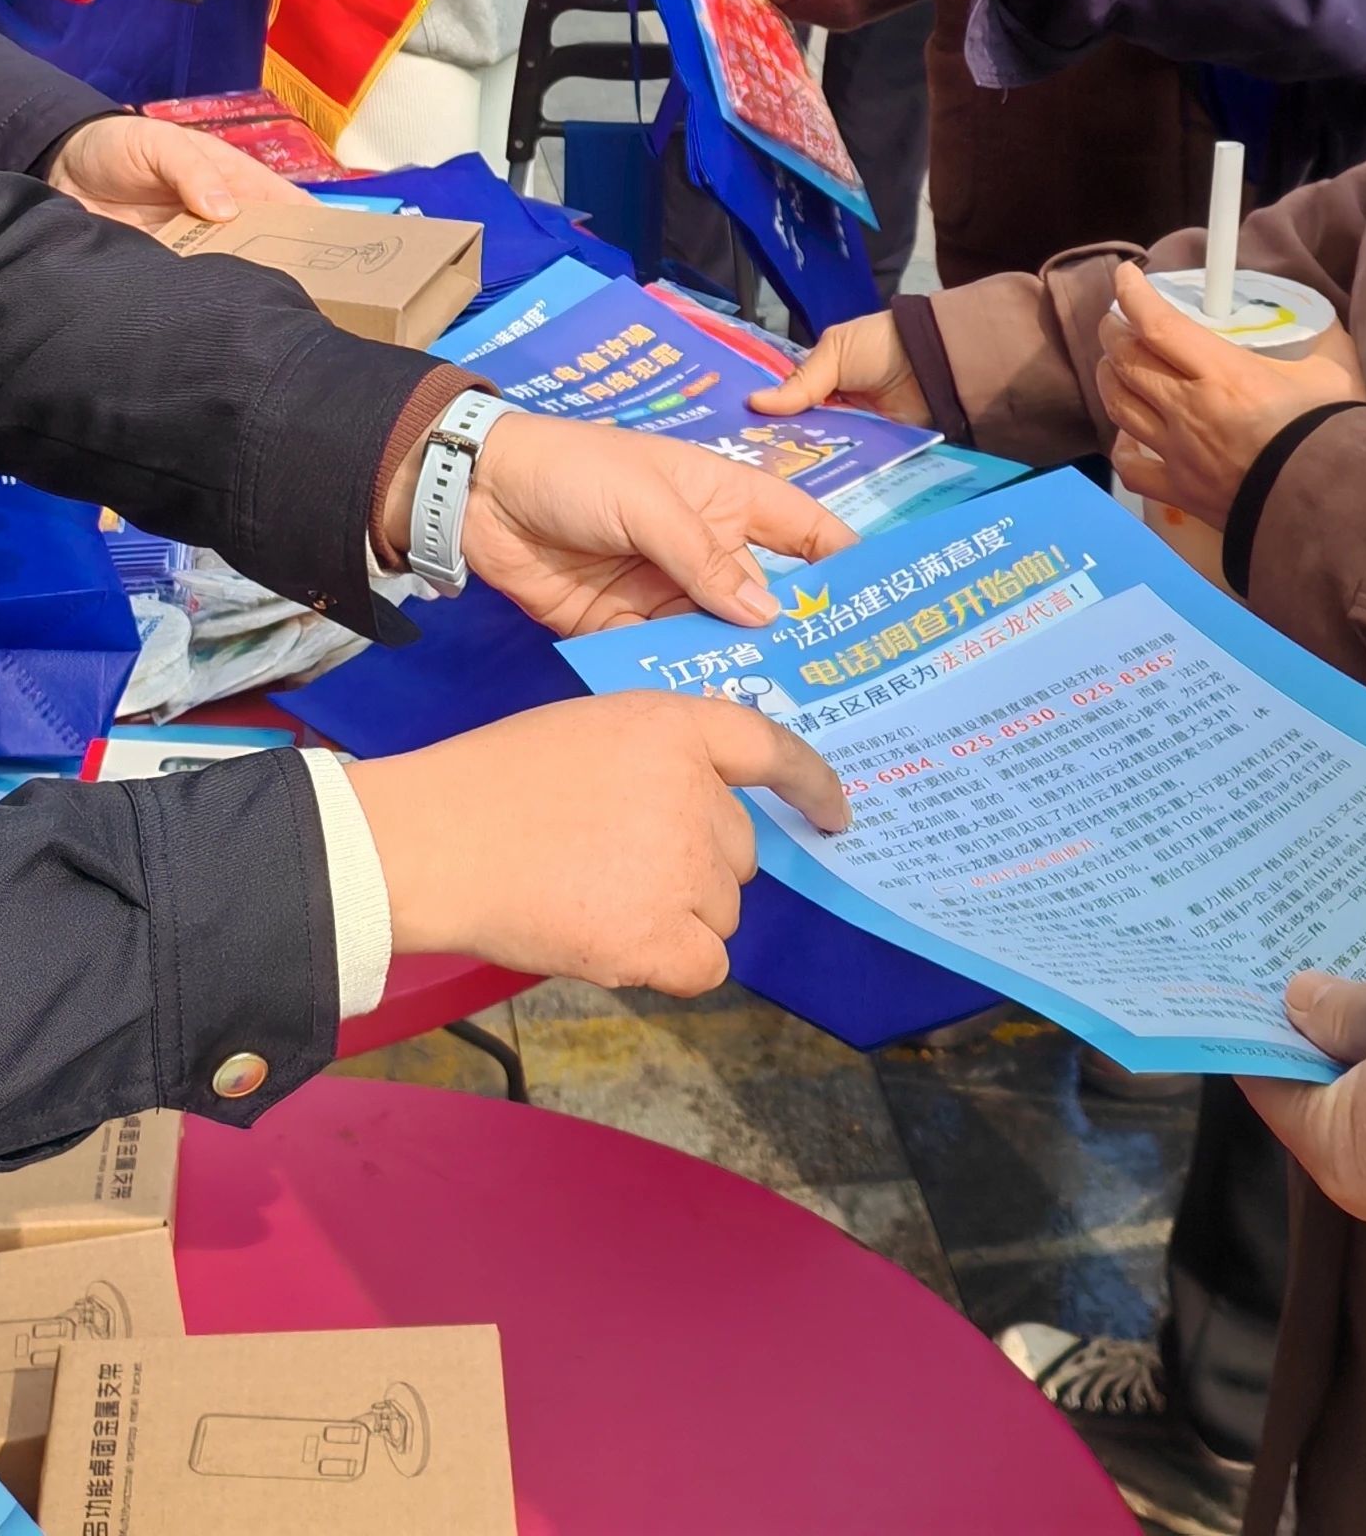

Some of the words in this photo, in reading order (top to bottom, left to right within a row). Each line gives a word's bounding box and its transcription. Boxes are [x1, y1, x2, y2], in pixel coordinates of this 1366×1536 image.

[504, 323, 657, 401] 防范电信诈骗
[536, 342, 685, 413] 打击网络犯罪
[638, 642, 764, 690] 「江苏省
[771, 516, 1015, 650] “法治建设满意度”
[82, 1363, 124, 1536] 多功能桌面金属支架
